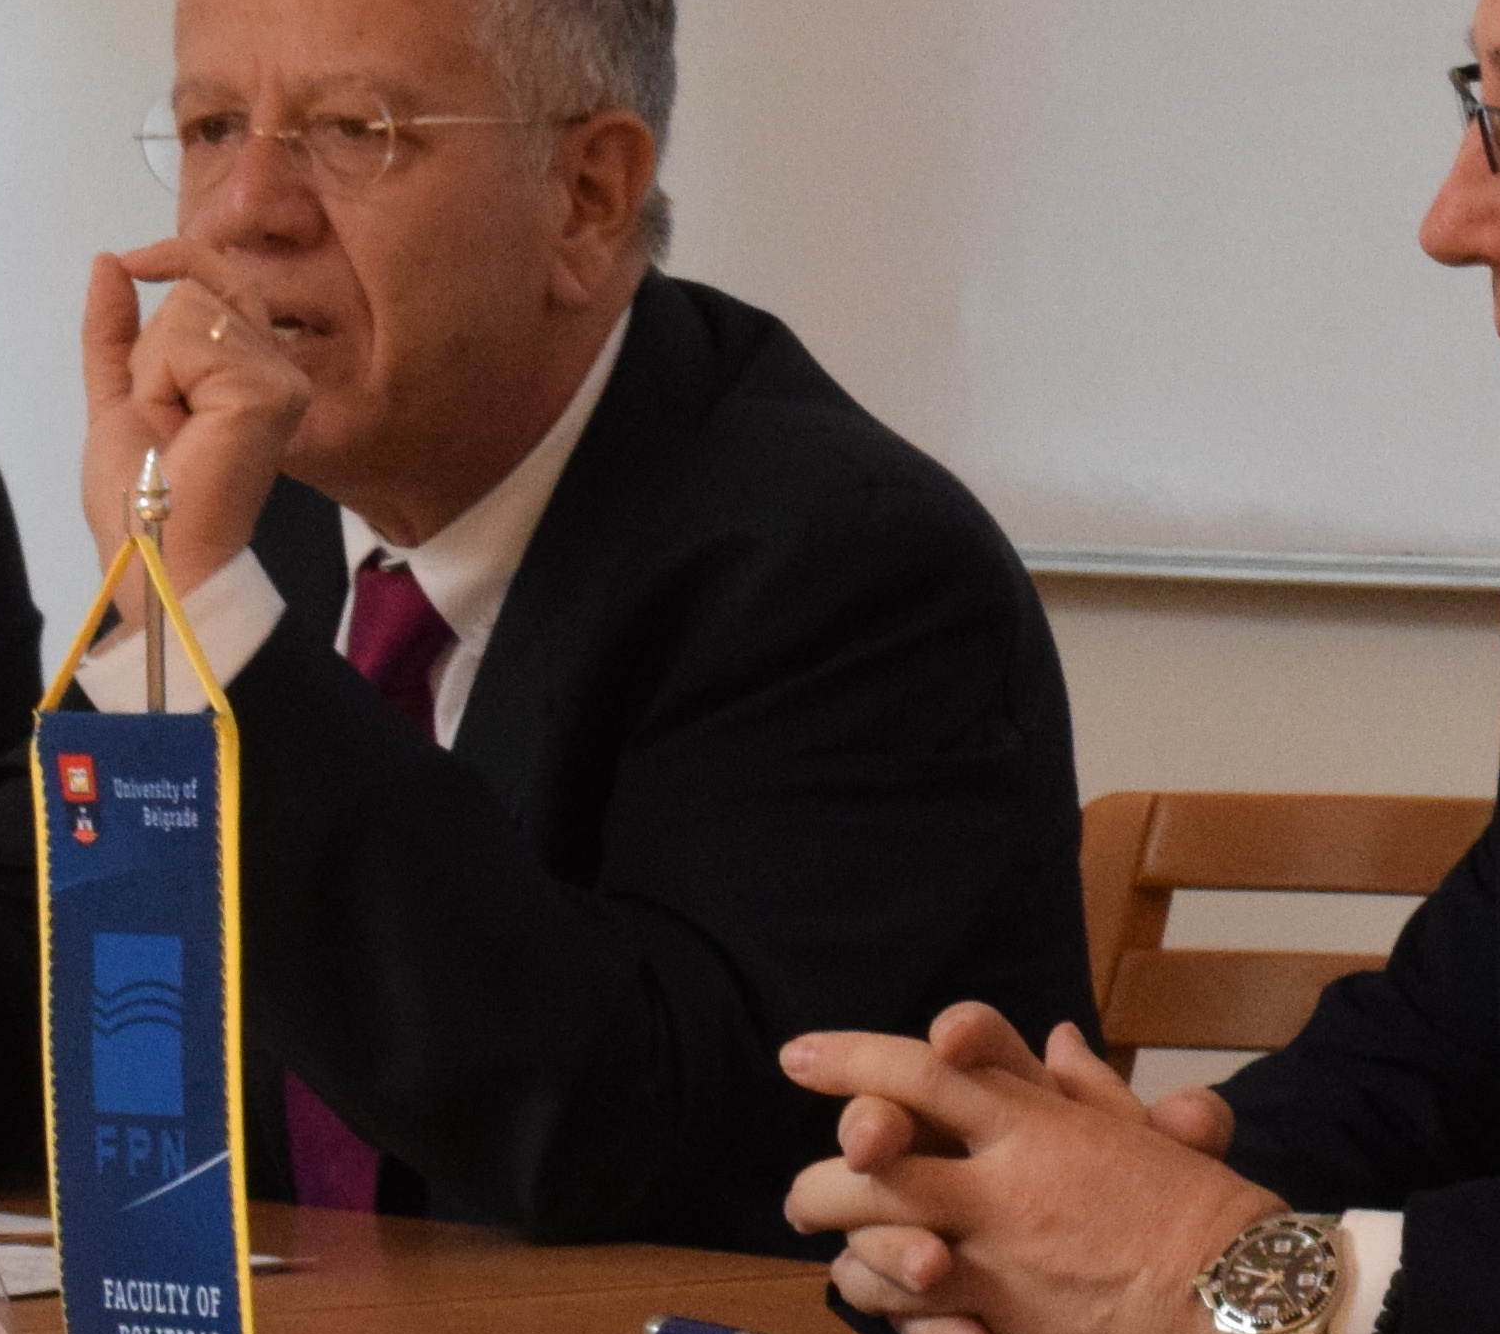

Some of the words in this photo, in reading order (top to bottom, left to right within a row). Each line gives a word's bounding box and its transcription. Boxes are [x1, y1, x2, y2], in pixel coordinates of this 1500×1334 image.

[113, 777, 180, 804] University
[182, 776, 198, 799] of
[143, 806, 199, 833] Belgrade
[95, 1125, 186, 1179] FPN
[103, 1277, 190, 1316] FACULTY
[196, 1285, 221, 1318] OF
